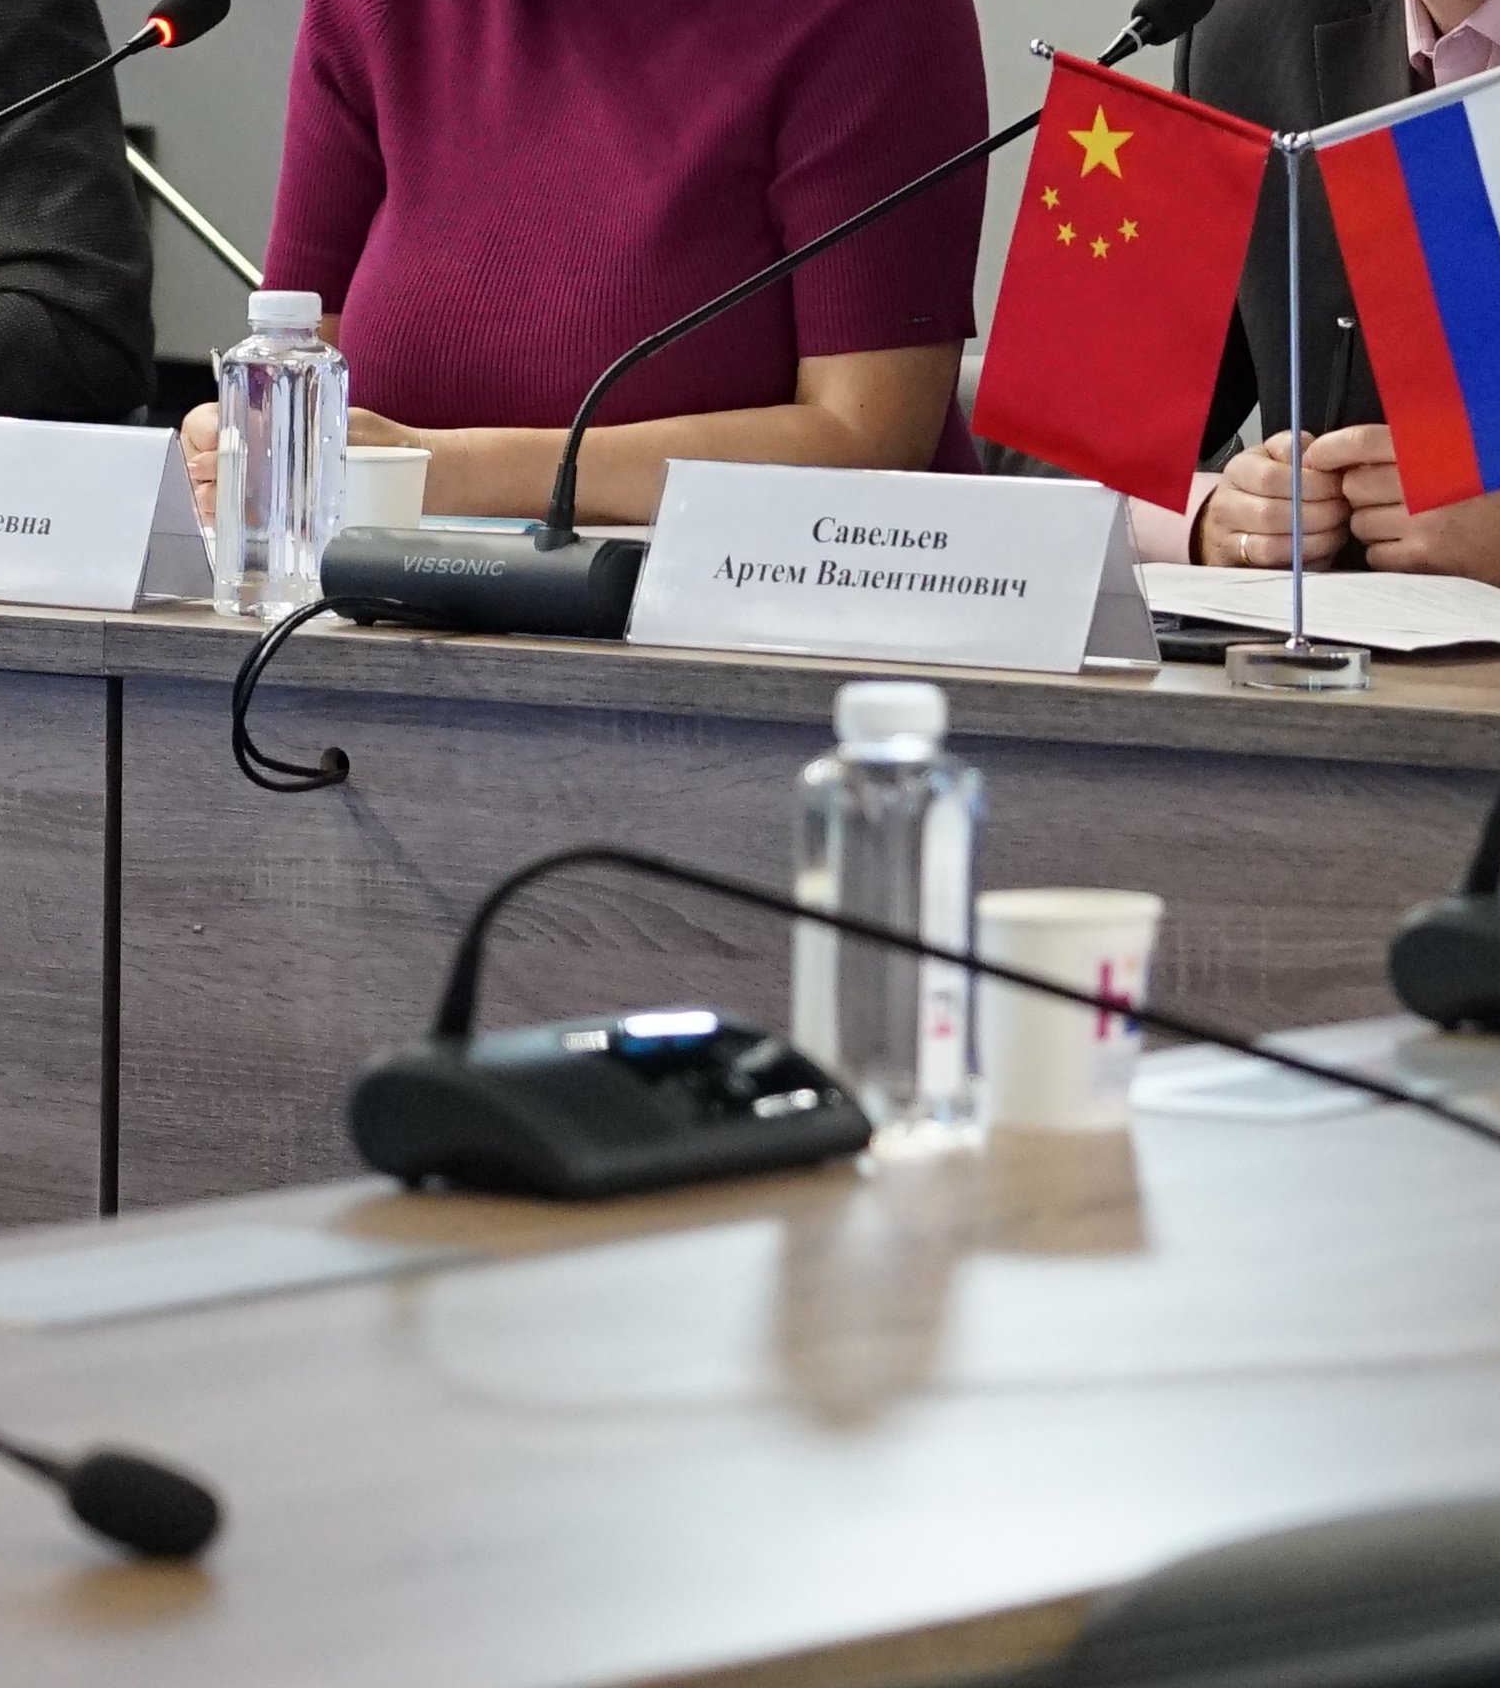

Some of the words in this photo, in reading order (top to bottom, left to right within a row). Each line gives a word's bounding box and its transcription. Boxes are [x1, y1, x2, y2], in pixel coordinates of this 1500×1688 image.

[812, 516, 948, 550] Савельев
[403, 555, 506, 577] VISSONIC
[712, 554, 807, 588] Артем
[815, 559, 1028, 599] Валентинович
